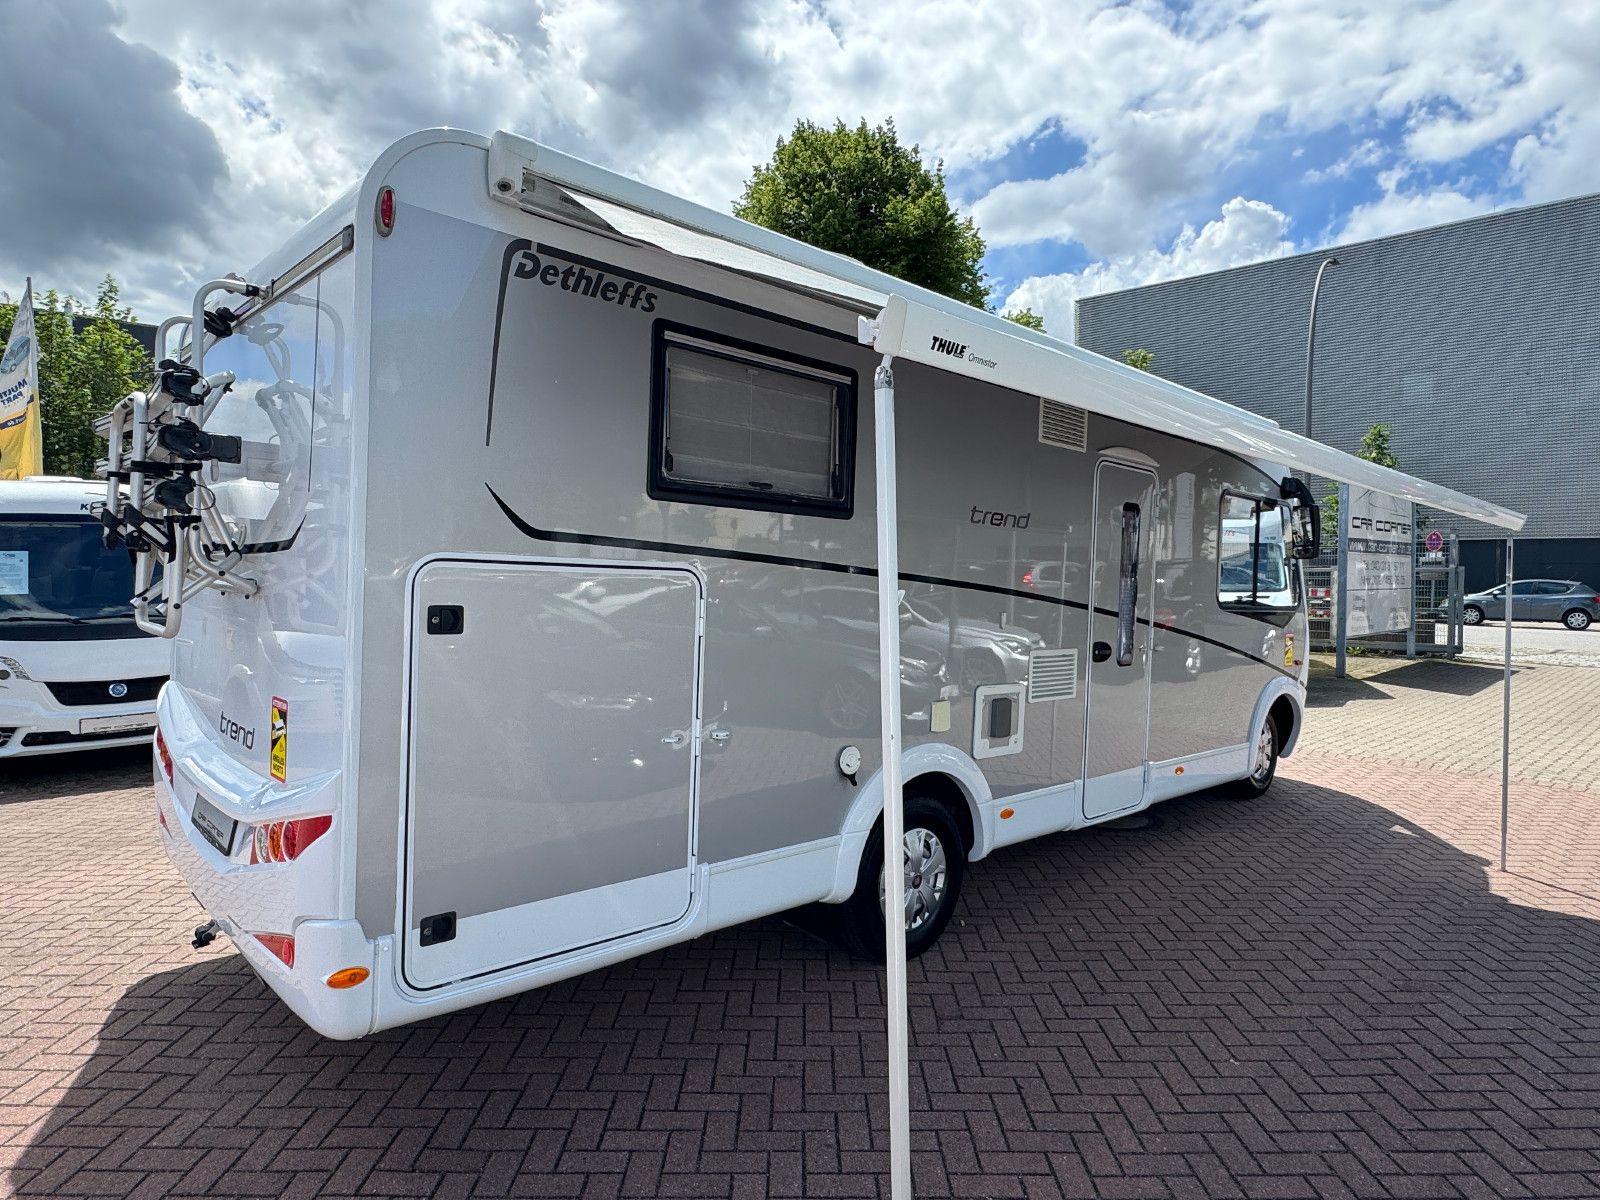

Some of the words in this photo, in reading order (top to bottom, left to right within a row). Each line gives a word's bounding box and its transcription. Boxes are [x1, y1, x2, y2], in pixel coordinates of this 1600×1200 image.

[514, 251, 658, 313] Dethleffs
[930, 336, 967, 359] THULE
[968, 353, 997, 369] Omnistor
[970, 505, 1031, 529] trend
[1352, 516, 1373, 531] CAR
[1376, 520, 1412, 535] CORNER
[219, 711, 255, 750] trend
